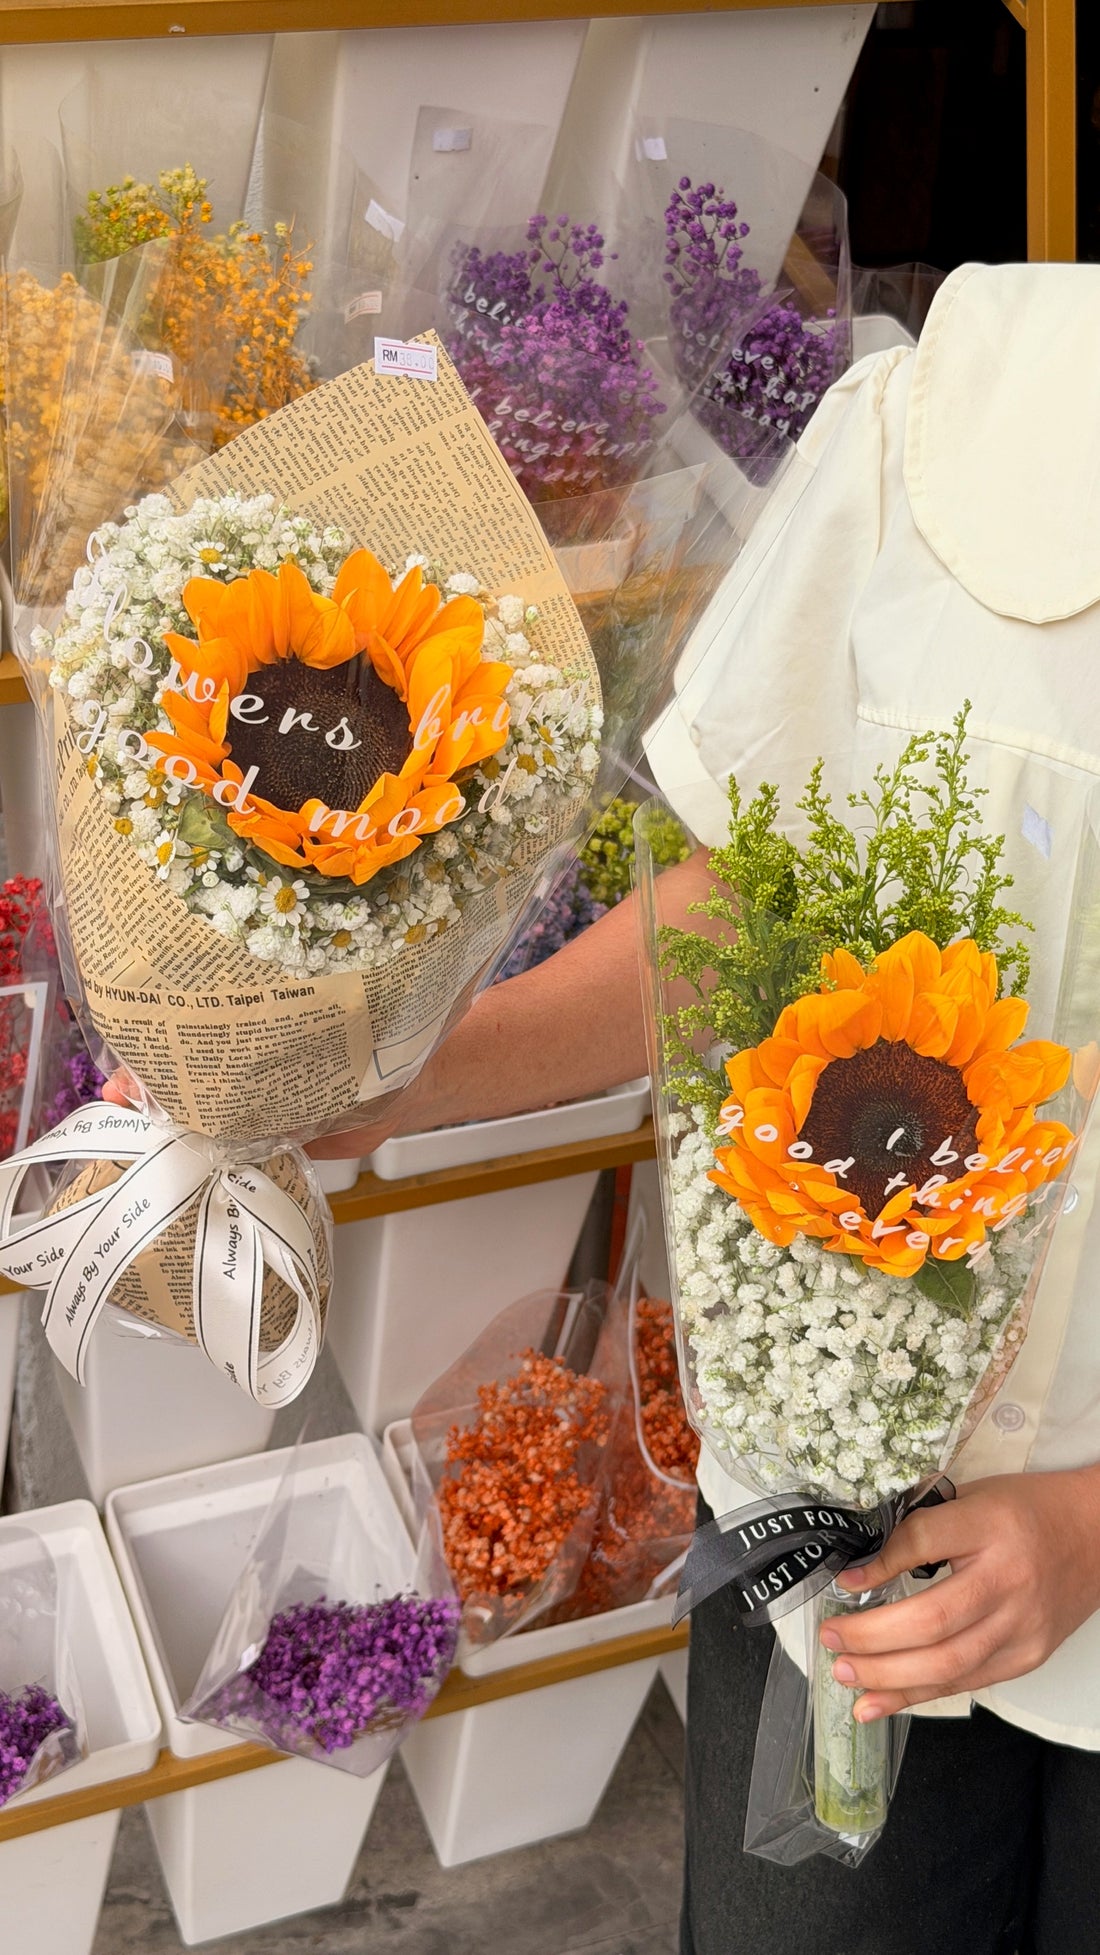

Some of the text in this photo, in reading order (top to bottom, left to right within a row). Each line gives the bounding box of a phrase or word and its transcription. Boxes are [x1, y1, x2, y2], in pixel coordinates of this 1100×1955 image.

[683, 319, 774, 370] beleve
[494, 396, 611, 434] believe
[763, 376, 816, 412] hap
[488, 420, 651, 464] hings hap
[413, 676, 589, 750] bring
[77, 700, 517, 841] good mood
[94, 981, 104, 998] by
[105, 984, 161, 1005] HYUN-DAI
[167, 993, 194, 1010] CO.,
[196, 993, 223, 1009] LTD.
[227, 988, 265, 1008] Taipei
[271, 984, 315, 1000] Taiwan
[235, 1018, 266, 1027] trained
[264, 1023, 291, 1032] horses
[74, 1119, 93, 1134] By
[98, 1115, 152, 1133] Always
[714, 1104, 856, 1179] good
[882, 1171, 1055, 1232] things
[929, 1135, 1084, 1174] believ
[222, 1218, 243, 1280] Always
[839, 1211, 992, 1269] every
[3, 1246, 65, 1277] Your Side
[65, 1282, 87, 1327] Always
[82, 1260, 99, 1283] By
[94, 1226, 120, 1259] Your
[122, 1198, 151, 1229] Side
[738, 1513, 795, 1551] JUST
[803, 1509, 850, 1530] FOR
[742, 1528, 838, 1612] JUST FOR
